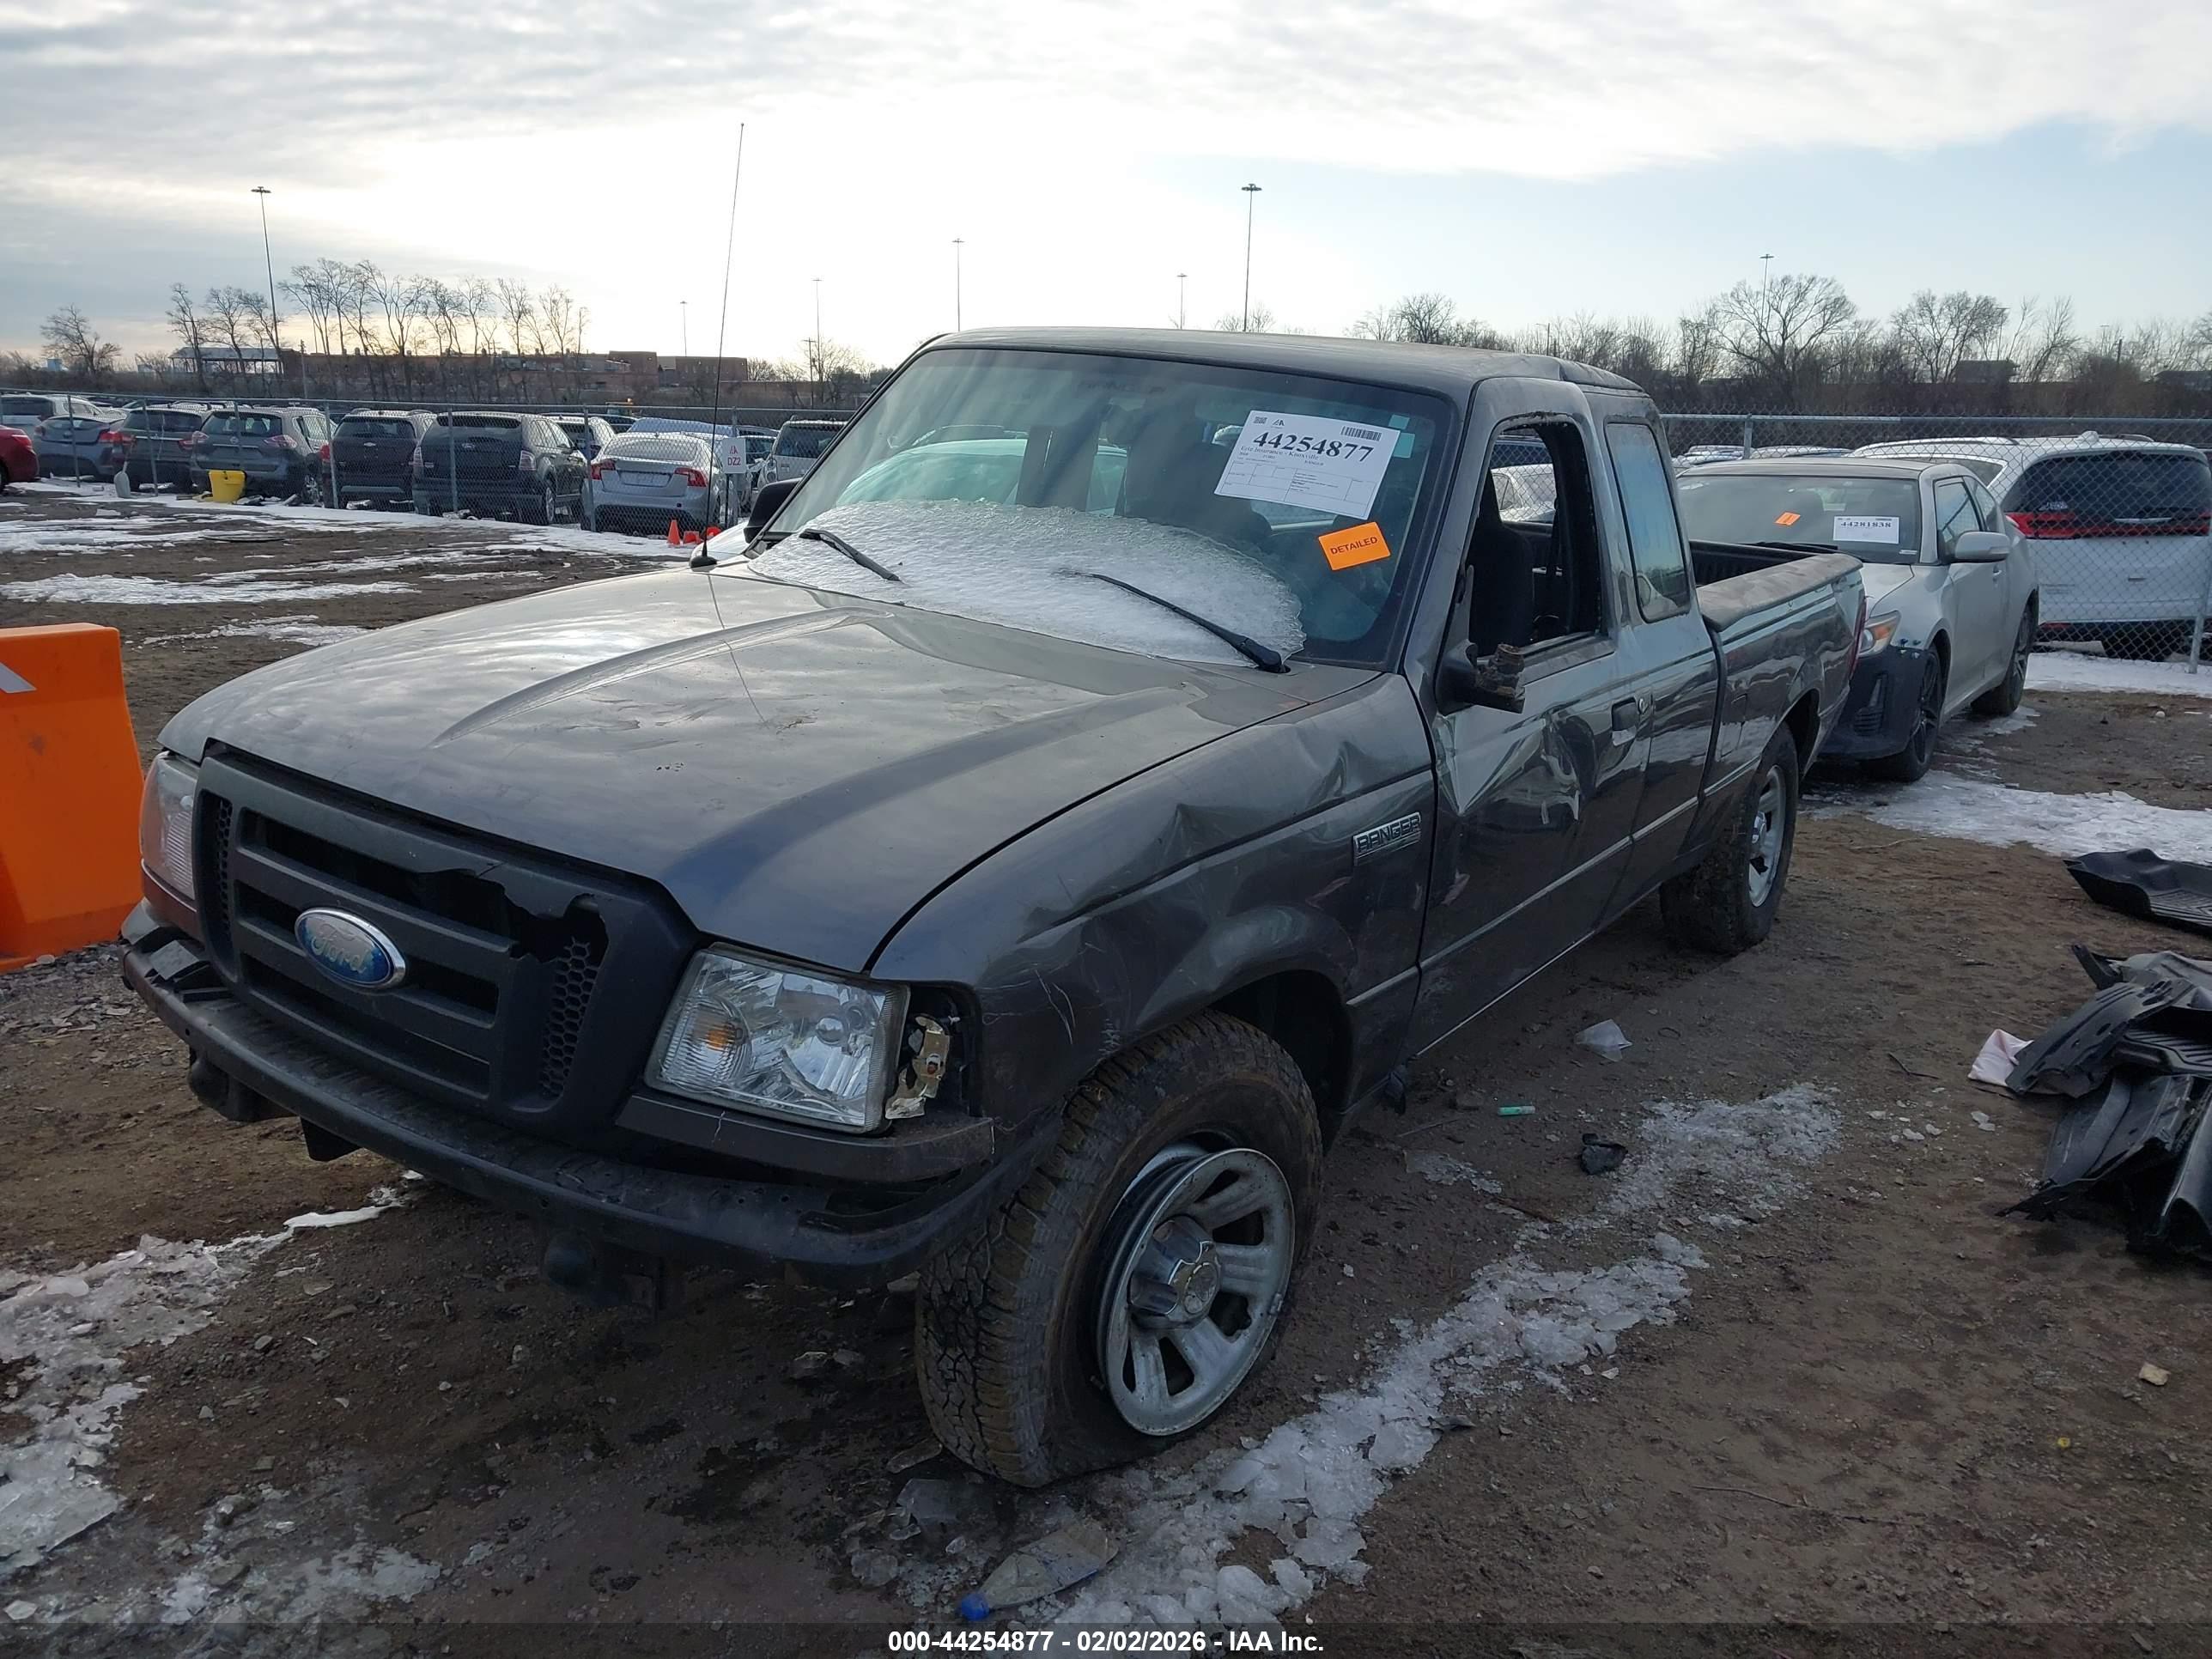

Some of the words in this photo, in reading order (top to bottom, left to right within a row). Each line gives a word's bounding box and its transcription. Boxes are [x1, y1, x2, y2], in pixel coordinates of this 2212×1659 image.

[1254, 432, 1374, 462] 44254877
[1330, 537, 1378, 555] DETAILED
[1356, 814, 1419, 854] RANGER
[311, 923, 374, 974] Ford
